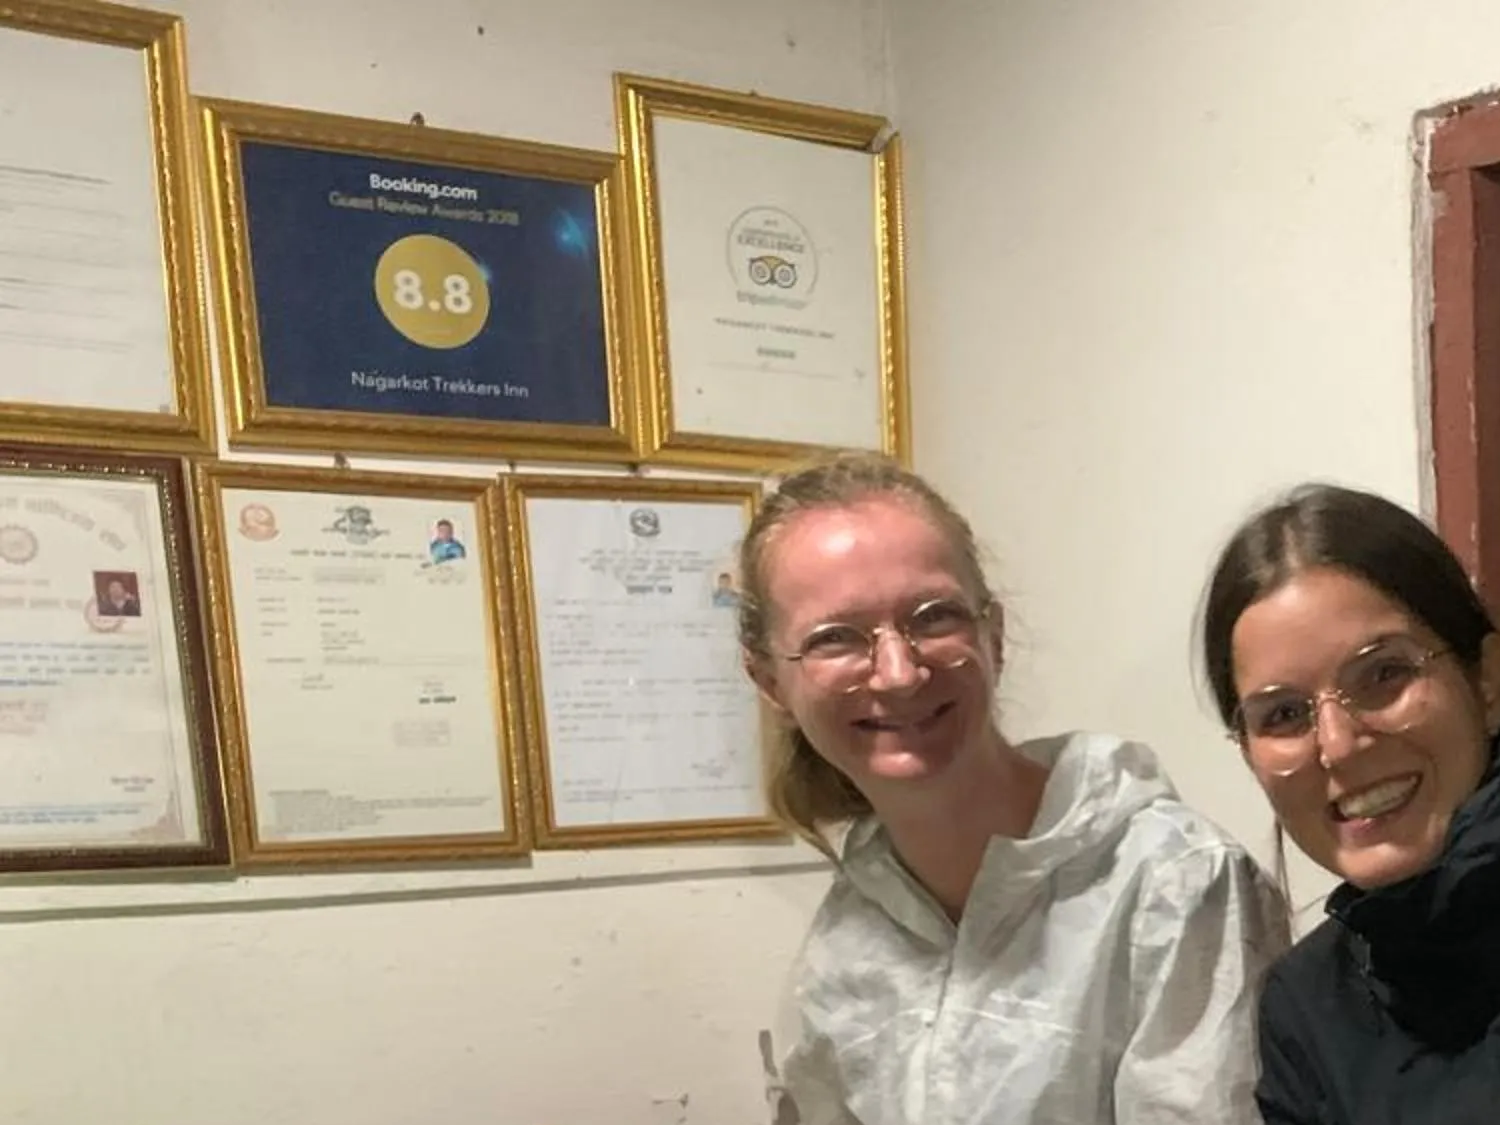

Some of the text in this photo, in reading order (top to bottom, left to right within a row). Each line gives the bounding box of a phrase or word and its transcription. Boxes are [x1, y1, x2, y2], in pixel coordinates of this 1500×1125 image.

[369, 173, 478, 200] Booking.com
[394, 269, 473, 315] 8.8
[351, 371, 529, 397] Nagarkot Trekkers Inn
